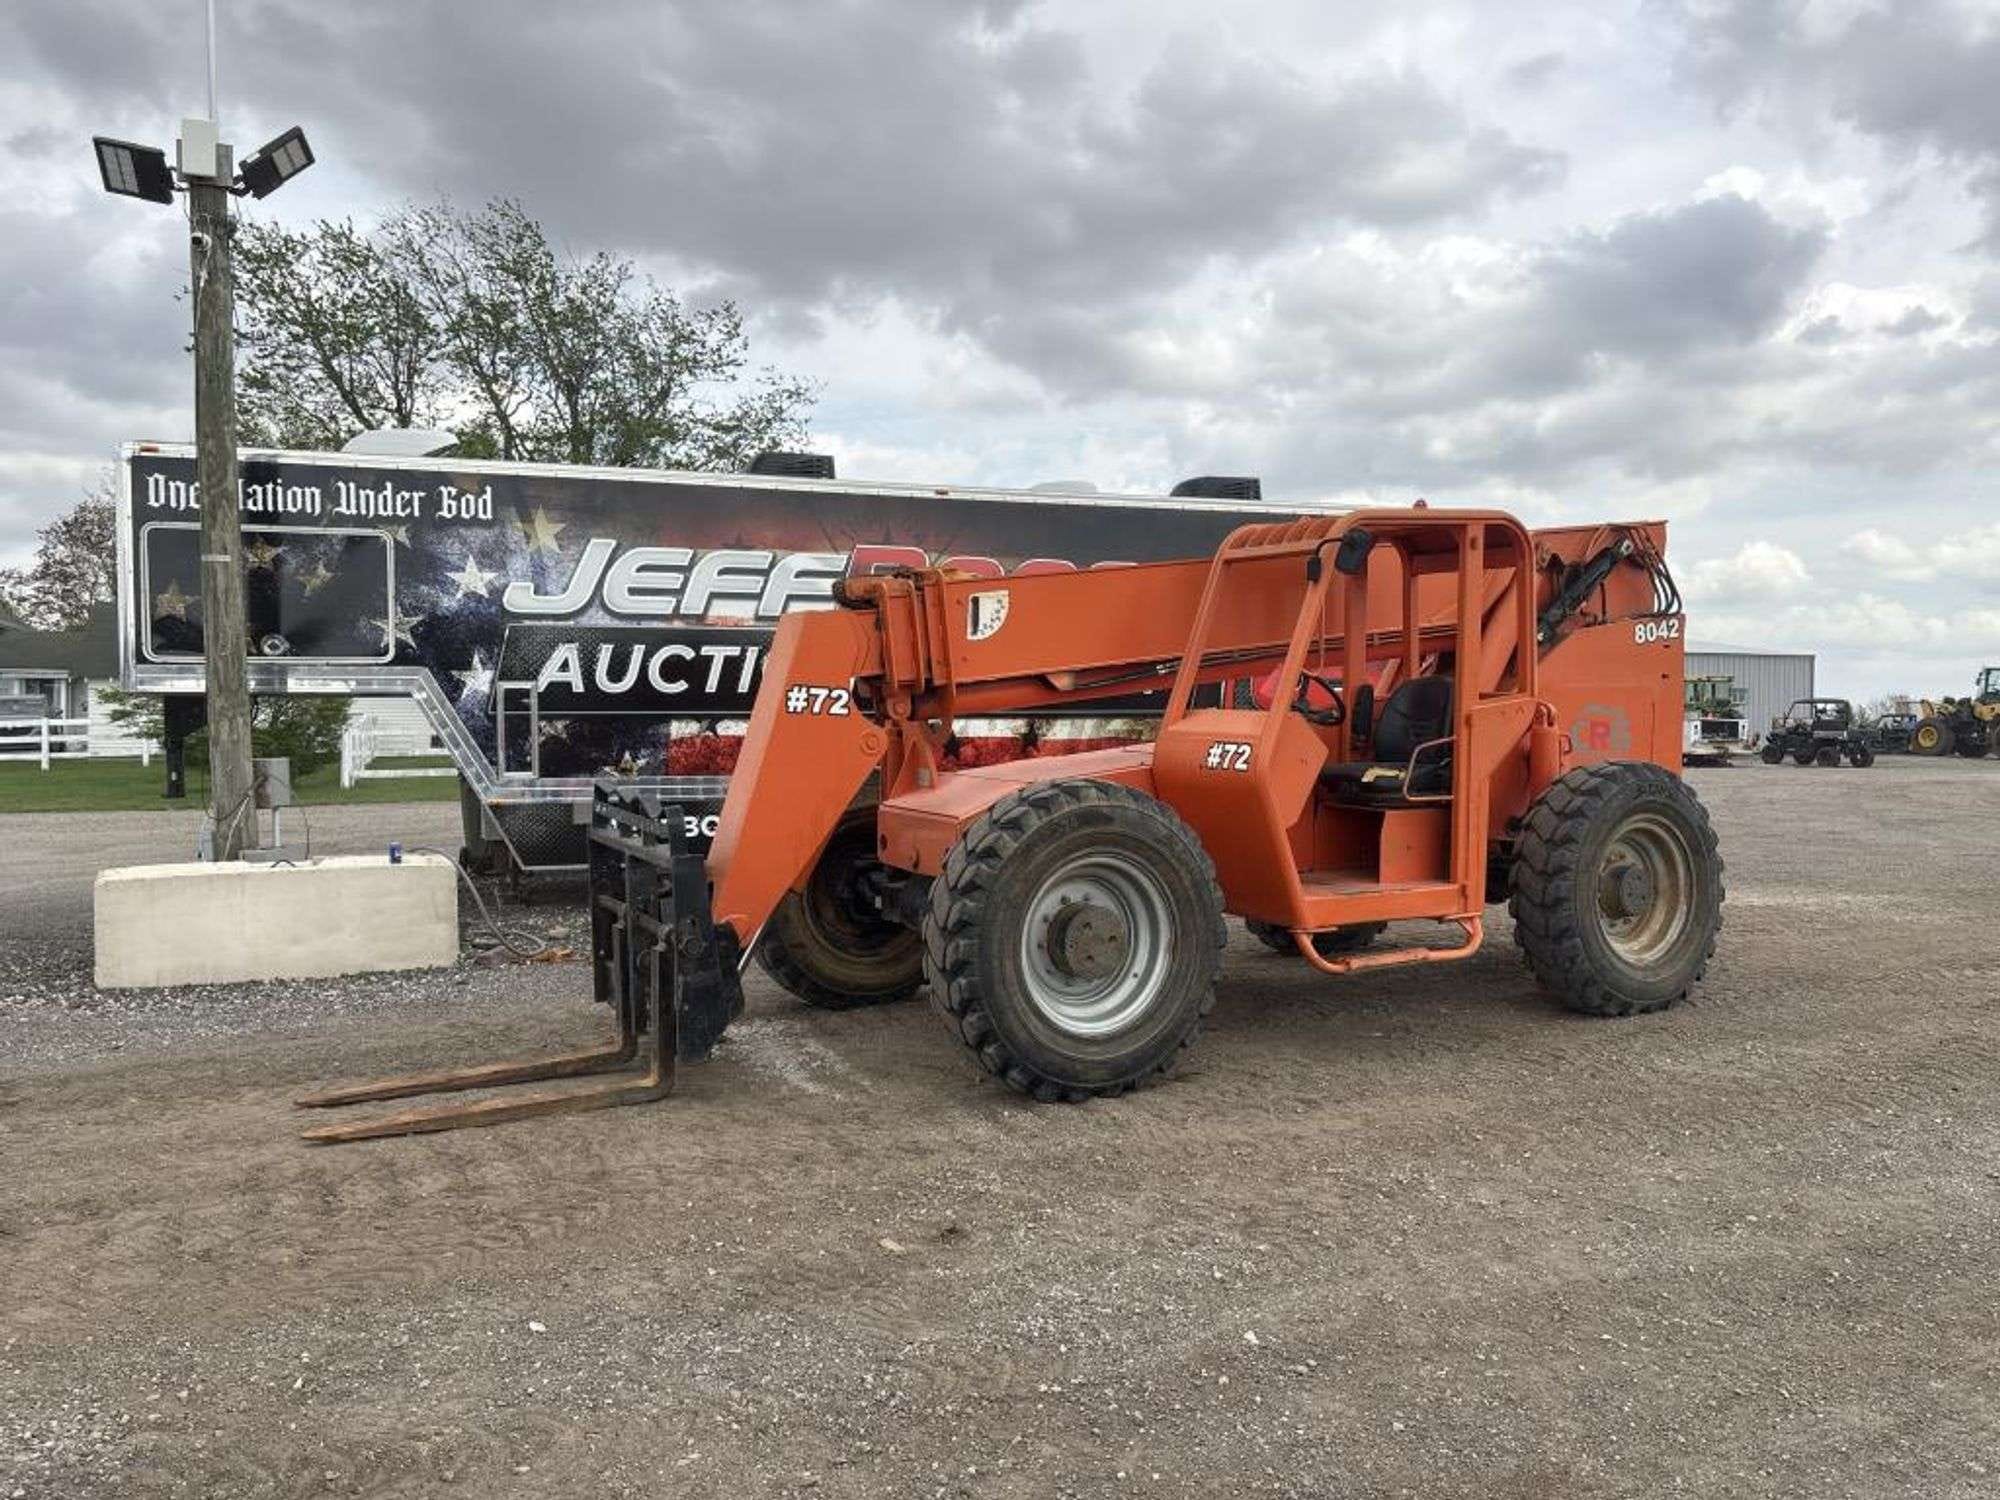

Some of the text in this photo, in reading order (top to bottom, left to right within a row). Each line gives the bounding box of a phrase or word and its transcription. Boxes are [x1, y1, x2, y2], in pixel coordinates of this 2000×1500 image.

[145, 472, 201, 511] One
[333, 480, 427, 520] Under
[436, 484, 494, 521] God
[1634, 618, 1680, 644] 8042
[785, 685, 851, 716] #72
[1206, 740, 1253, 772] #72
